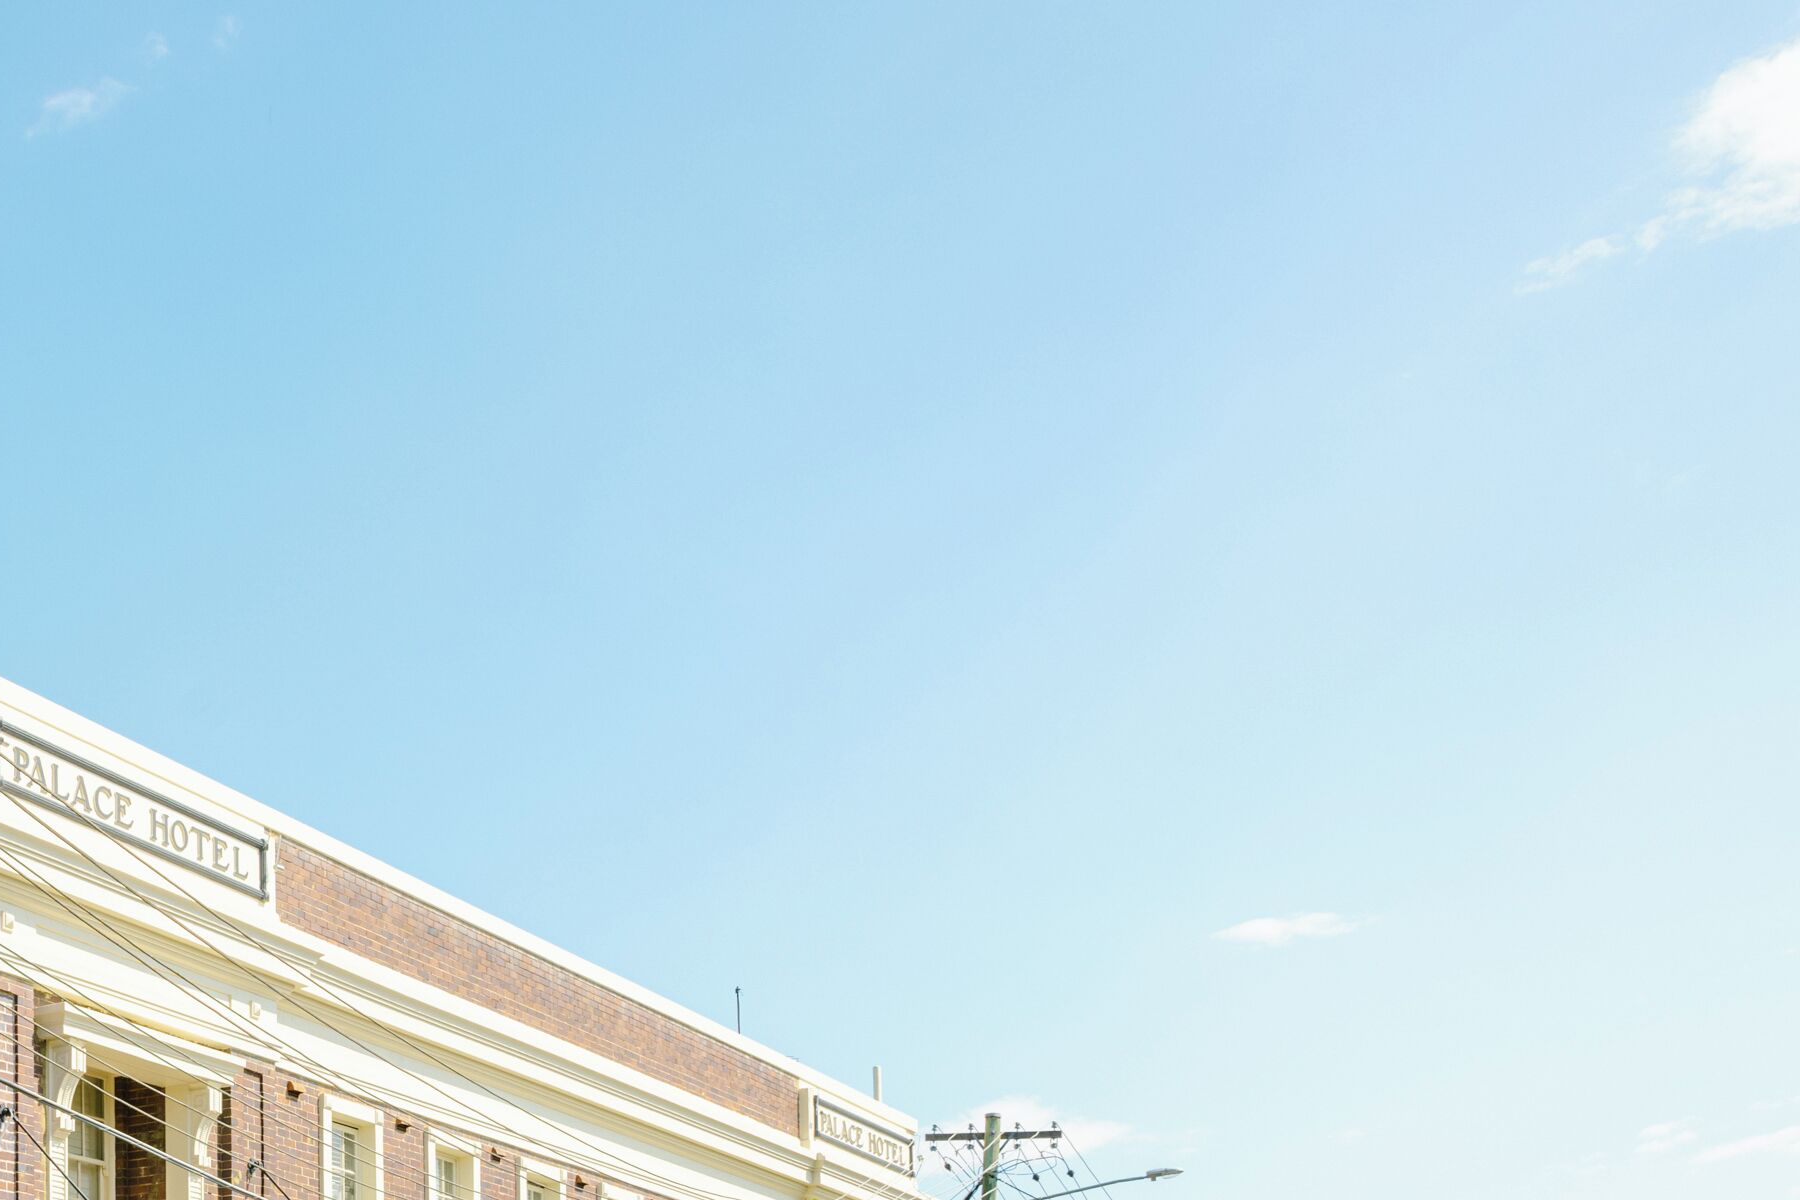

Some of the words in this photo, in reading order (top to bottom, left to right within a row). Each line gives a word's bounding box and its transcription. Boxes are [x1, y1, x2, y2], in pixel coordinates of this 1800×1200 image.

[12, 746, 134, 830] PALACE
[149, 808, 249, 881] HOTEL
[819, 1110, 864, 1148] PALACE
[868, 1132, 906, 1167] HOTEL
